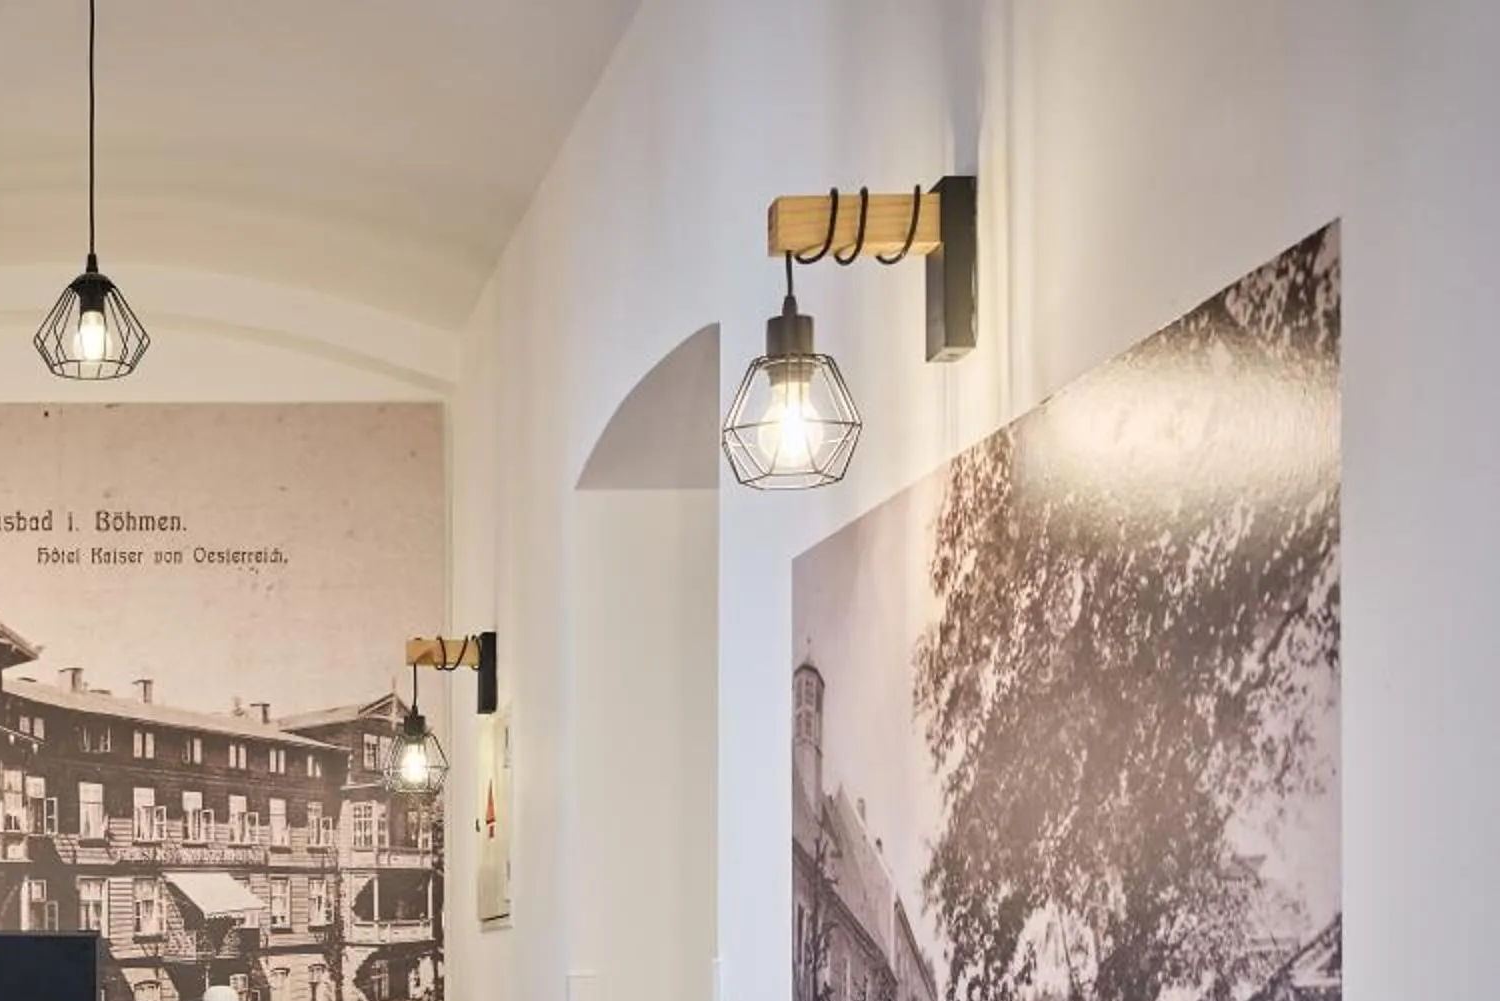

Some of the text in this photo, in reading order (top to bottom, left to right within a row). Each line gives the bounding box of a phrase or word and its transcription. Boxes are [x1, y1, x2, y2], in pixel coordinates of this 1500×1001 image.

[67, 512, 79, 532] i.
[95, 511, 187, 532] Böhmen.
[91, 547, 144, 564] Kaiser
[154, 550, 183, 564] von
[193, 547, 288, 564] Oesterreich.
